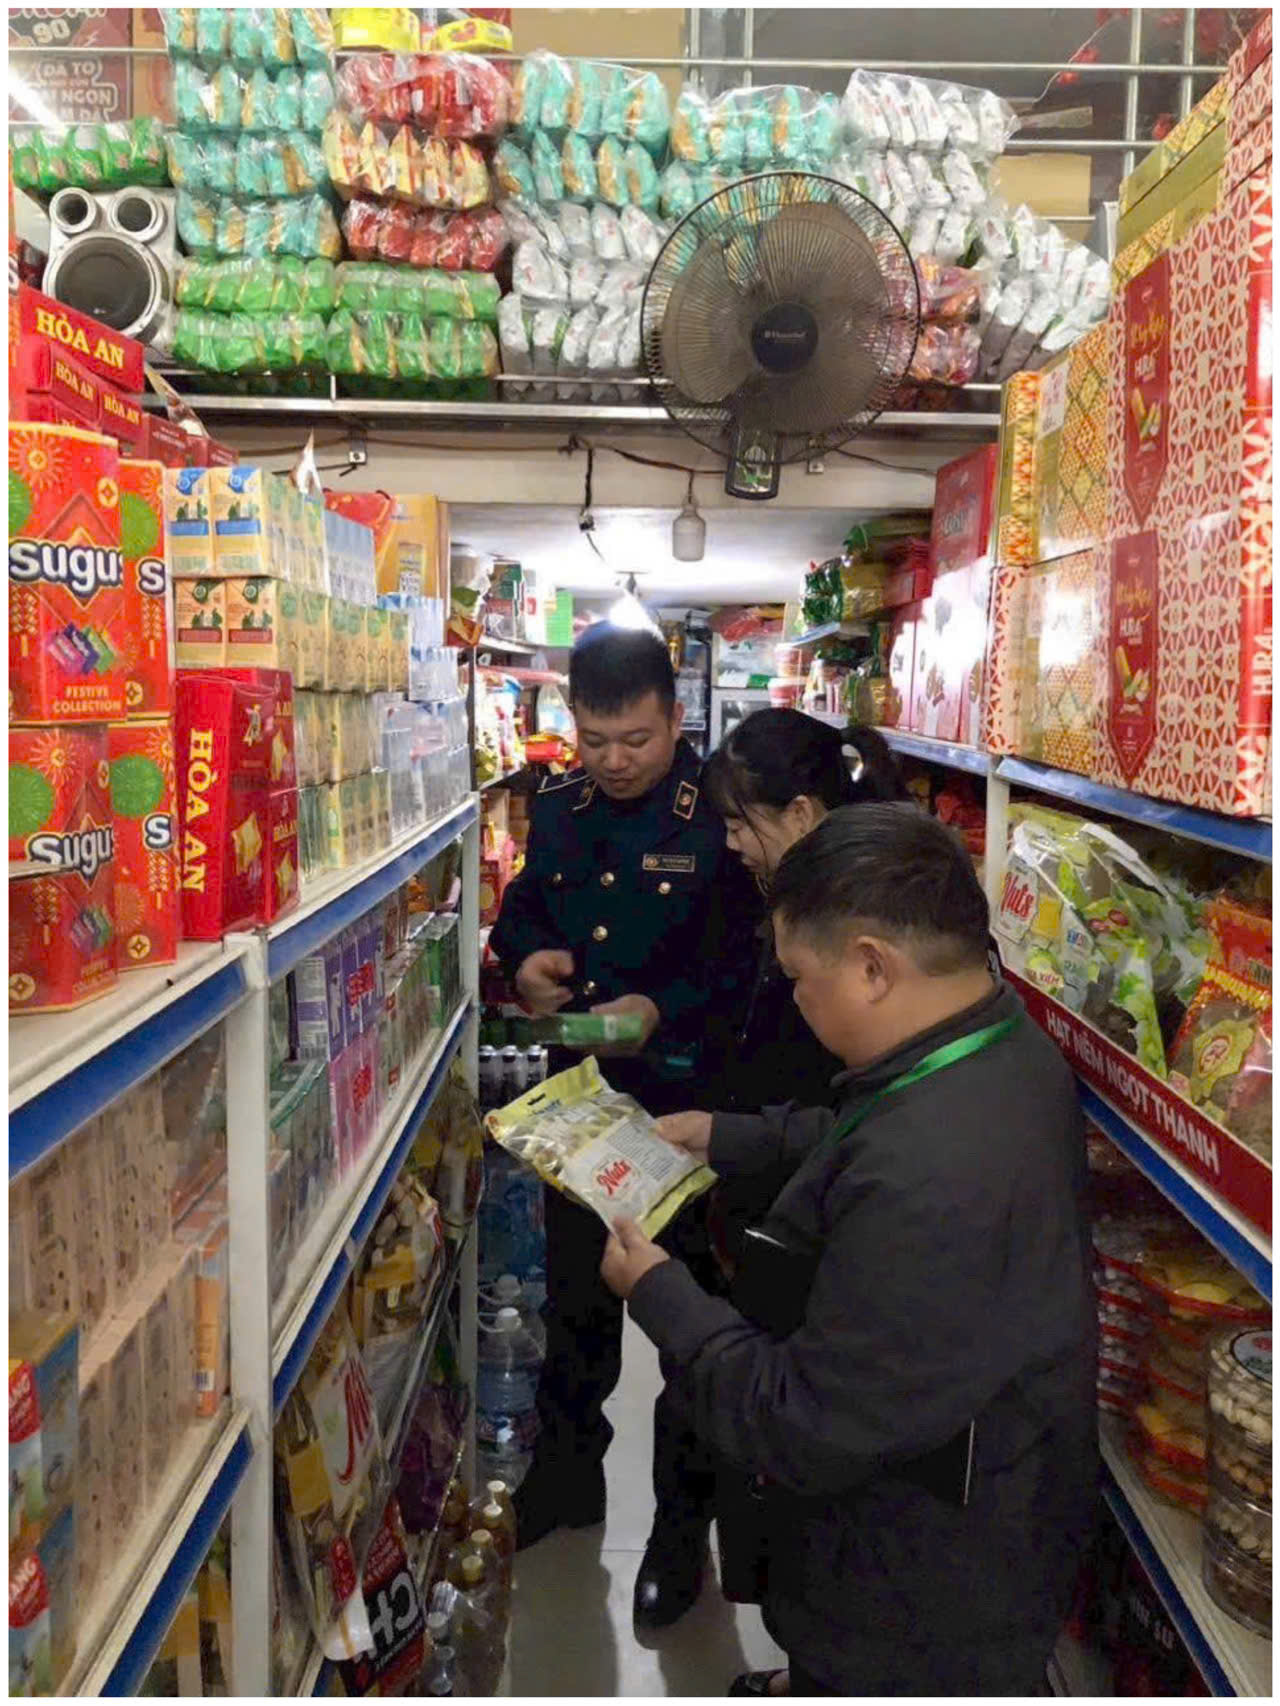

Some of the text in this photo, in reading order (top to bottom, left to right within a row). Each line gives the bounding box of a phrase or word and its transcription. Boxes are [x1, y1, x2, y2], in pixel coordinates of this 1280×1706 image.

[33, 18, 71, 43] 90
[93, 338, 125, 369] AN
[9, 541, 123, 592] Sugu
[182, 830, 208, 893] AN
[1150, 1091, 1220, 1175] THANH
